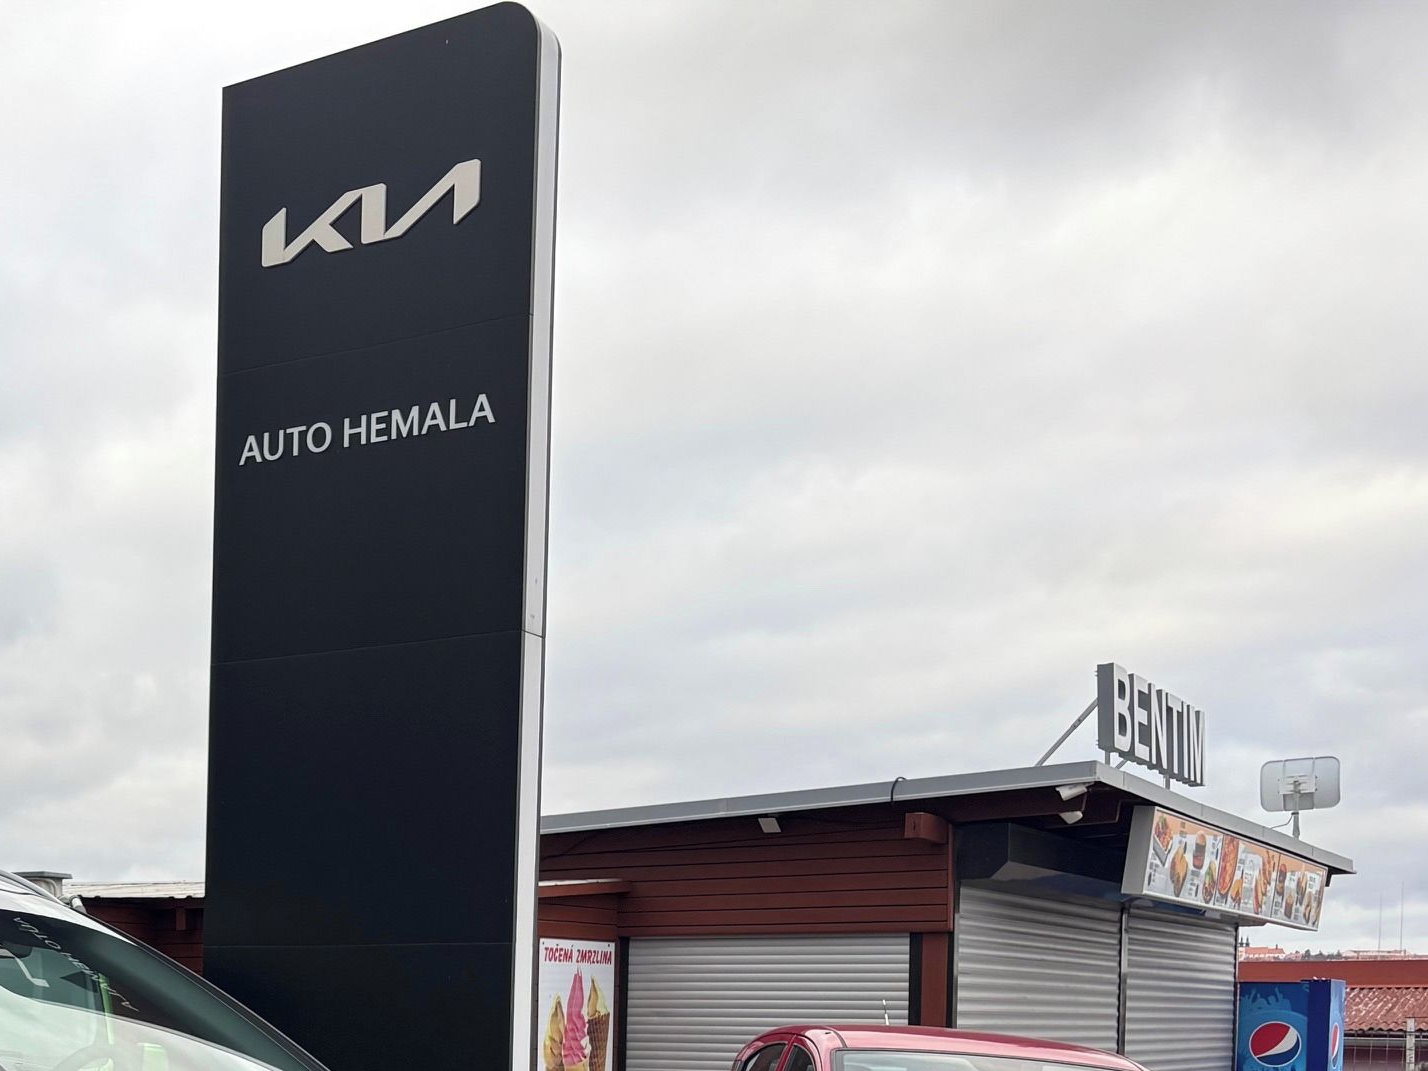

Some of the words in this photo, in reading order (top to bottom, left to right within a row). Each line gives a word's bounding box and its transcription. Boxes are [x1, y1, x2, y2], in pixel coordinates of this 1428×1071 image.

[262, 158, 481, 268] KIA
[238, 422, 332, 466] AUTO
[343, 393, 496, 449] HEMALA
[1098, 662, 1205, 786] BENTIM
[544, 943, 574, 963] TOČENÁ
[575, 949, 612, 966] ZMRZLINA
